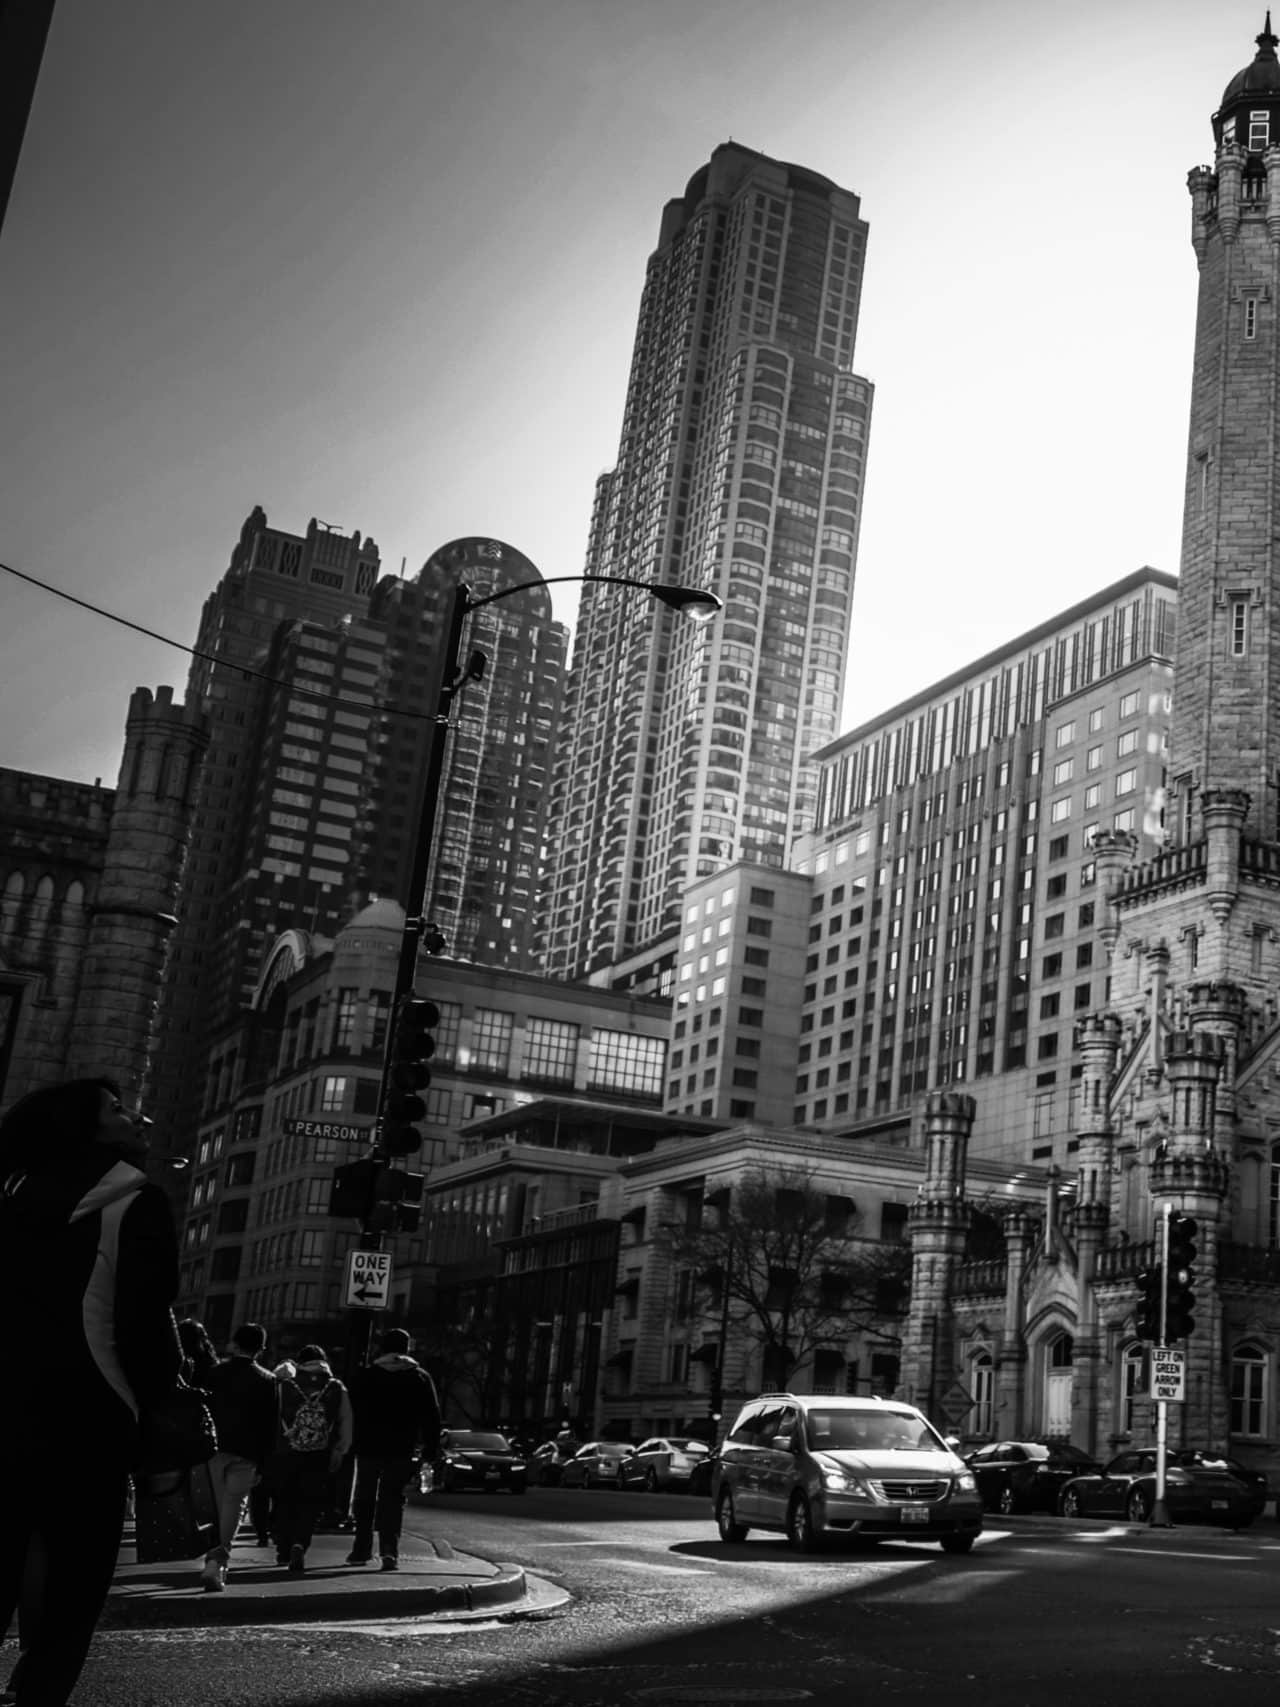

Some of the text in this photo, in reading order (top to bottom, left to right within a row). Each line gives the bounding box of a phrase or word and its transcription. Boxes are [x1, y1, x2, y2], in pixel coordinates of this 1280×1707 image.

[295, 1121, 359, 1141] PEARSON
[355, 1255, 388, 1270] ONE
[353, 1271, 387, 1285] WAY
[1153, 1351, 1171, 1361] LEFT
[1156, 1363, 1180, 1373] GREEN
[1155, 1375, 1181, 1385] ARROW
[1158, 1387, 1177, 1397] ONLY
